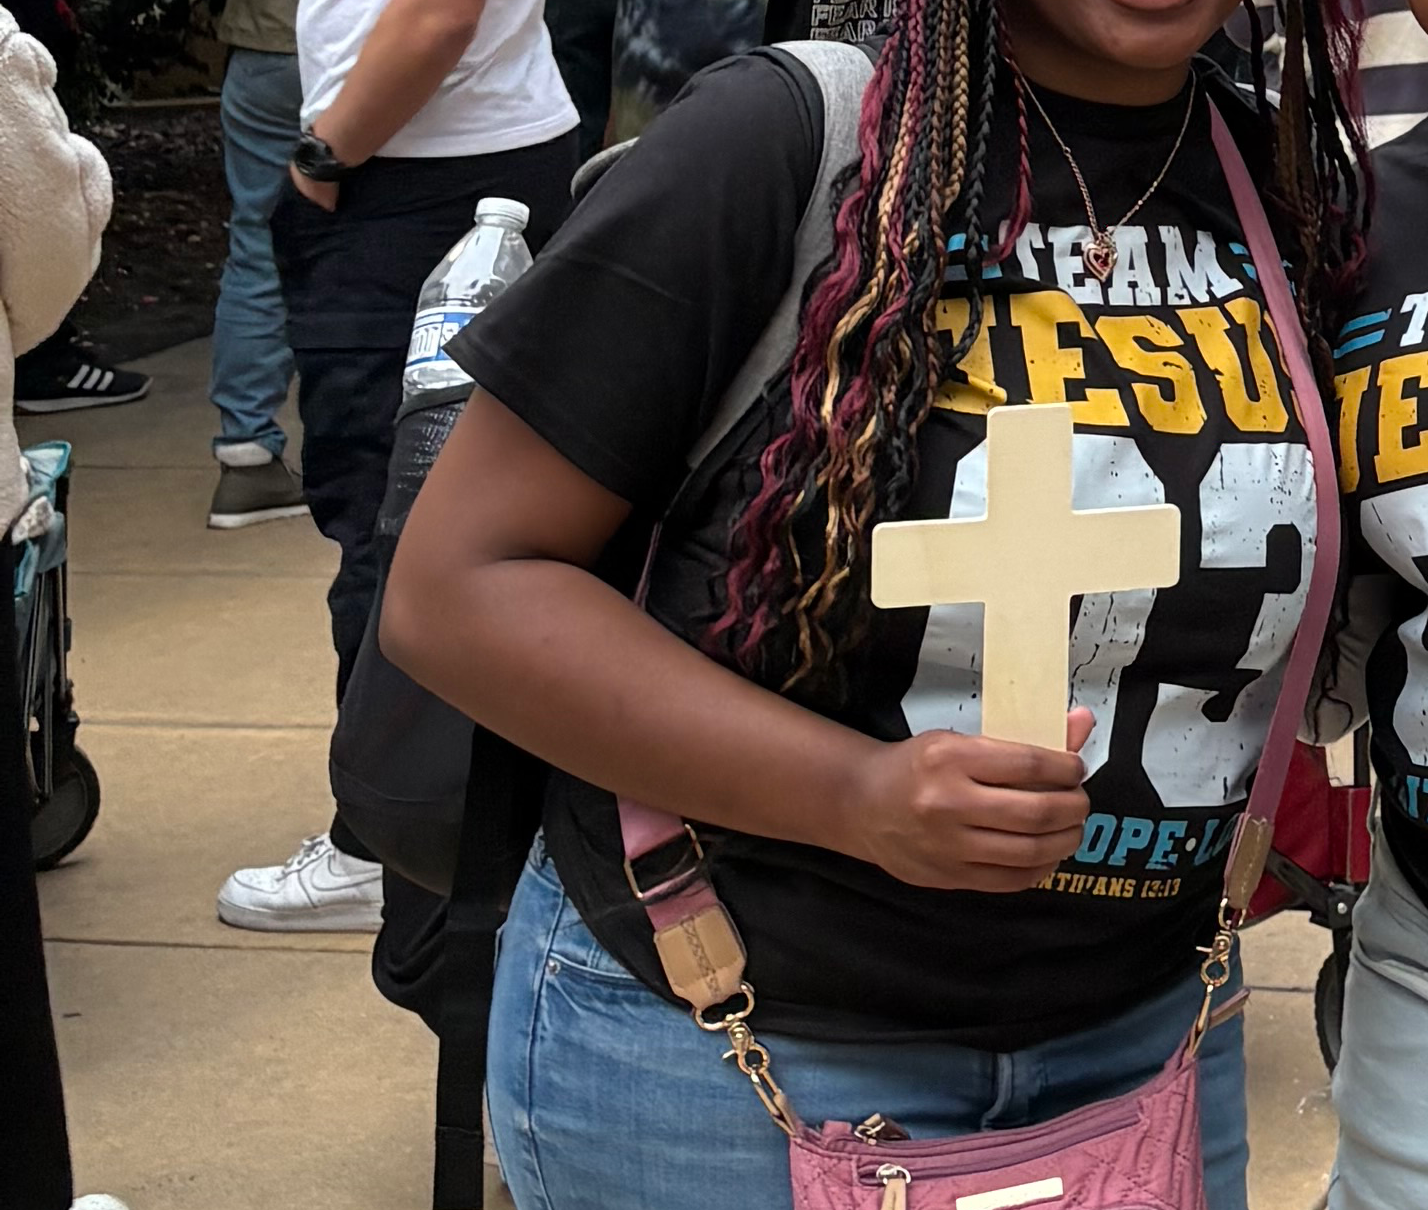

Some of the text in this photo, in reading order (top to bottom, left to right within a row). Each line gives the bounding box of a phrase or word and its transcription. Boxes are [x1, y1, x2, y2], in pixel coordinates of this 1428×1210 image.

[1000, 220, 1244, 306] TEAM
[934, 290, 1308, 435] JESU
[1074, 813, 1189, 870] OPE
[1038, 872, 1136, 898] NTHIANS
